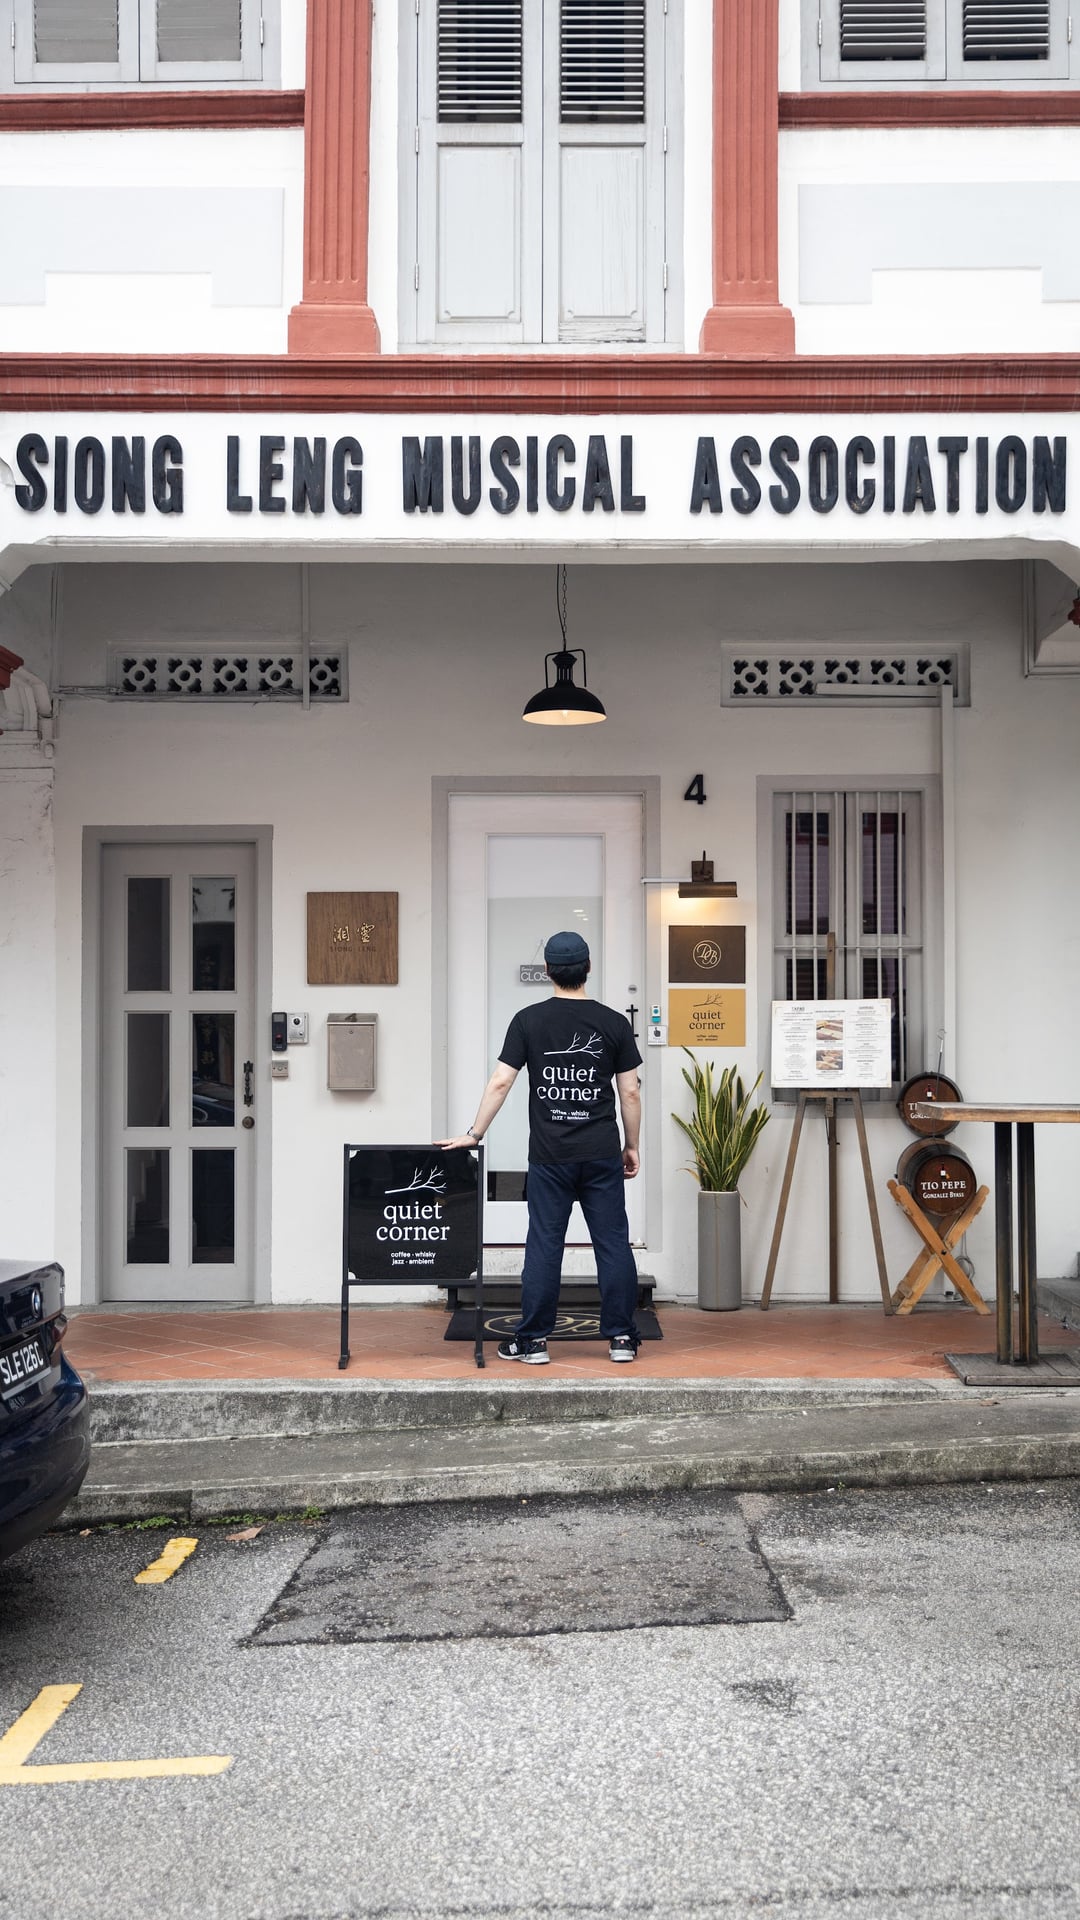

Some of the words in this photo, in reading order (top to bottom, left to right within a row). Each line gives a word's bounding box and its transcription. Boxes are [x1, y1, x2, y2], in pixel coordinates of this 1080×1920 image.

[15, 433, 184, 515] SIONG
[227, 435, 363, 515] LENG
[402, 434, 646, 515] MUSICAL
[690, 435, 1067, 515] ASSOCIATION
[684, 774, 707, 805] 4
[520, 971, 553, 982] CLOS
[693, 1010, 721, 1022] quiet
[689, 1022, 726, 1030] corner
[542, 1064, 596, 1085] quiet
[536, 1086, 601, 1101] corner
[907, 1102, 918, 1111] TI
[920, 1181, 939, 1191] TIO
[941, 1180, 967, 1190] PEPE
[383, 1200, 443, 1224] quiet
[376, 1226, 450, 1241] corner
[414, 1251, 437, 1259] whisky
[392, 1258, 405, 1266] jazz
